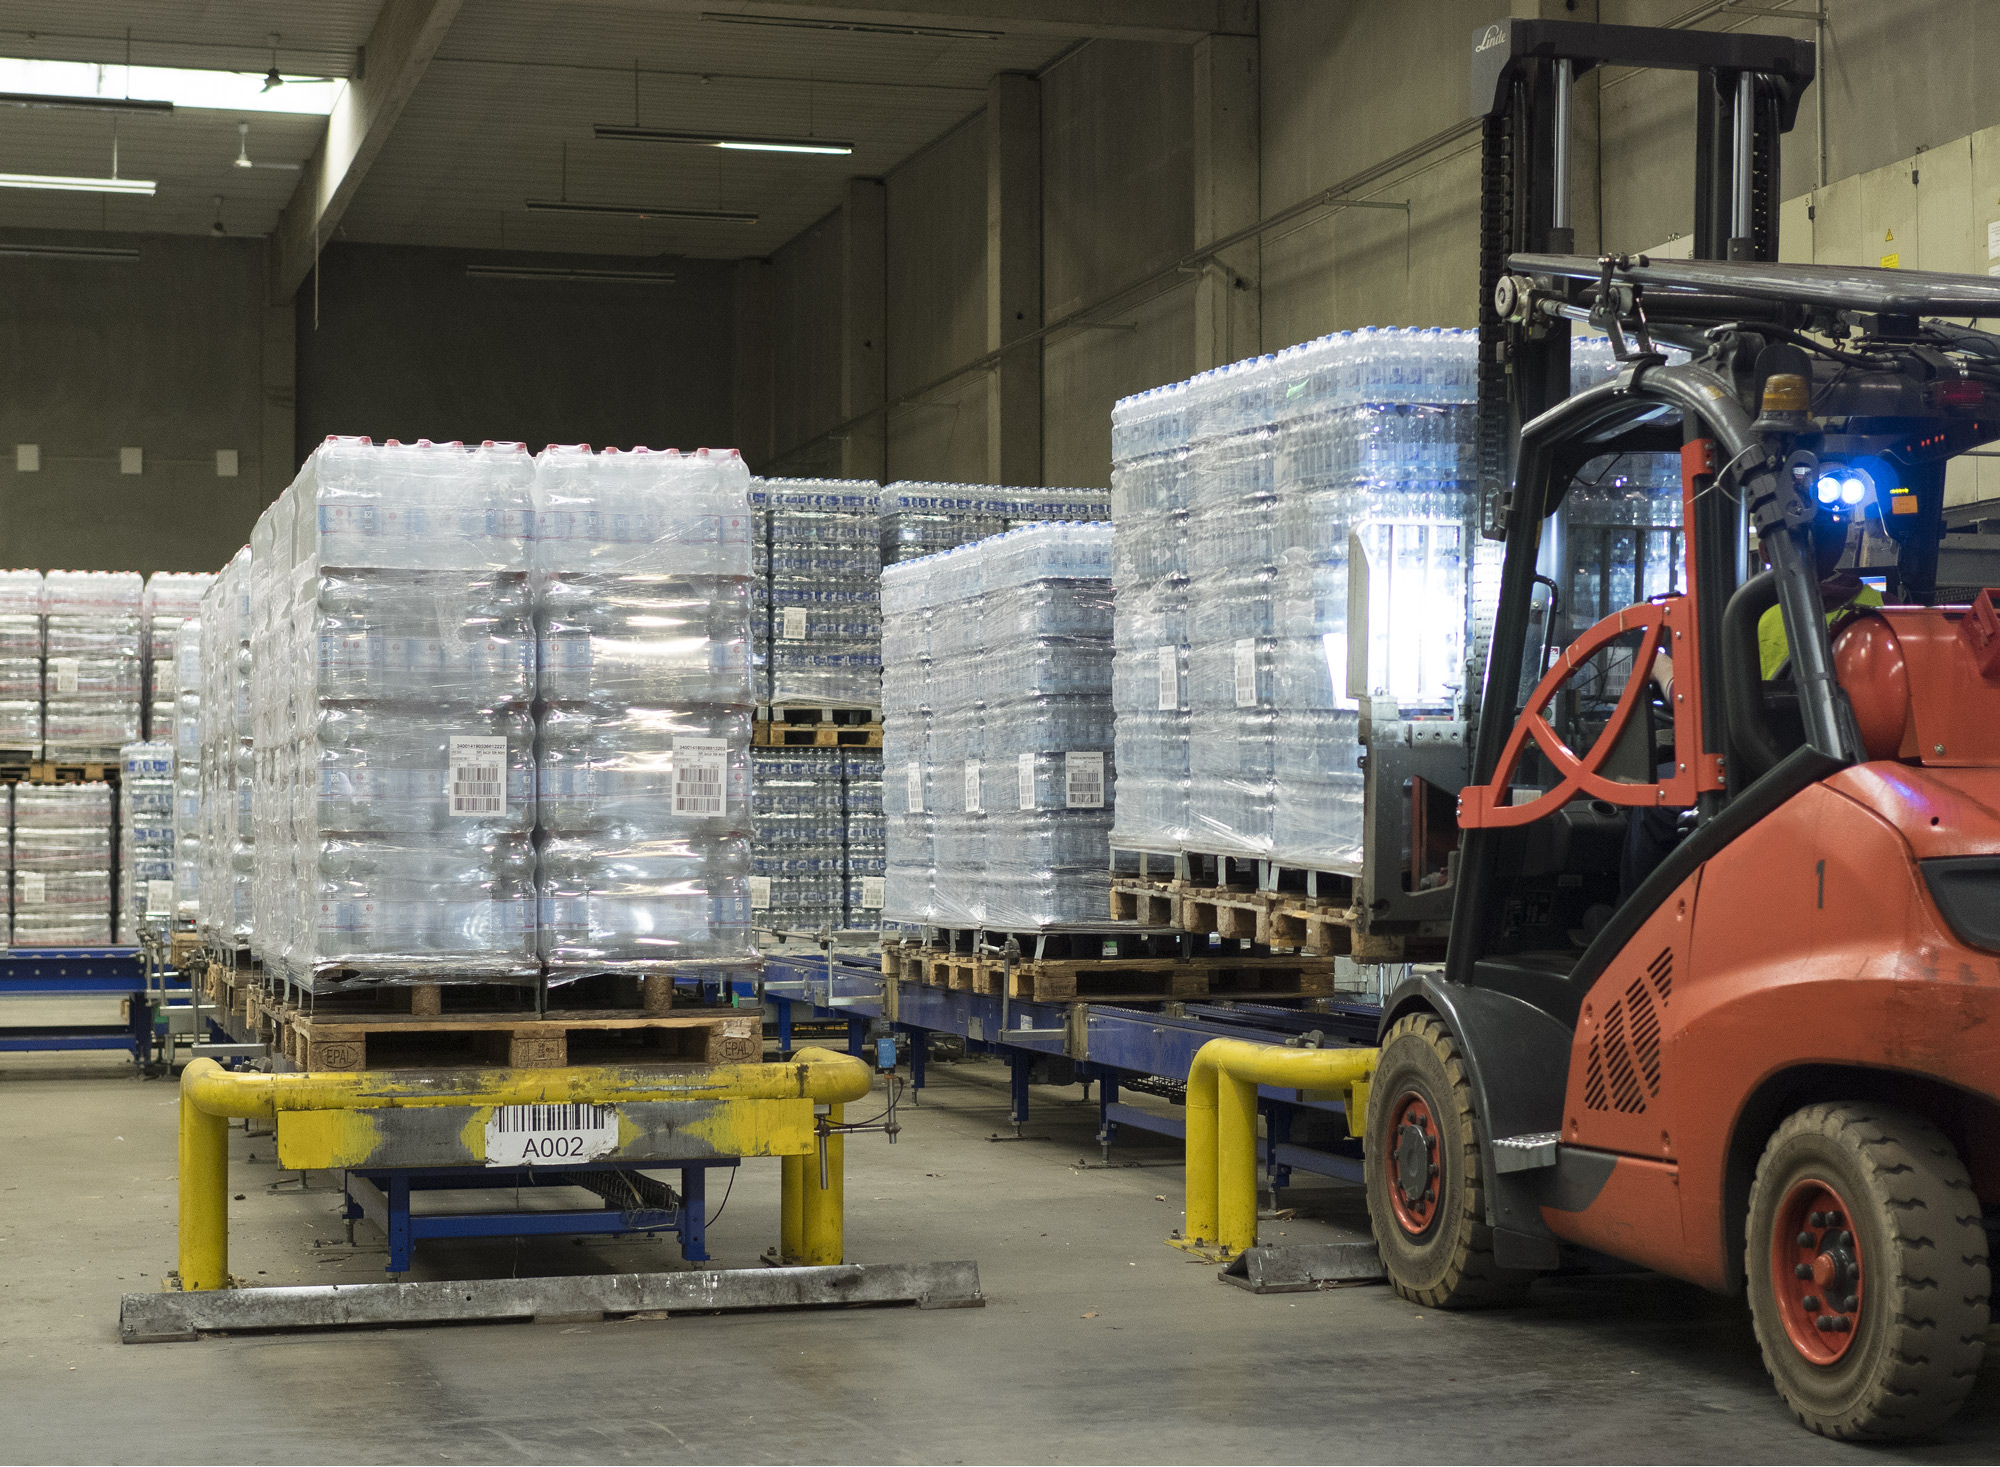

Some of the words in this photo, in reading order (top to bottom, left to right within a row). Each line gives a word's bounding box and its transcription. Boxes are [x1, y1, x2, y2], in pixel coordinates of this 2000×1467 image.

[1475, 25, 1507, 53] Linde
[1816, 858, 1825, 909] 1
[326, 1049, 352, 1064] EPAL
[726, 1041, 750, 1056] EPAL
[521, 1136, 584, 1158] A002
